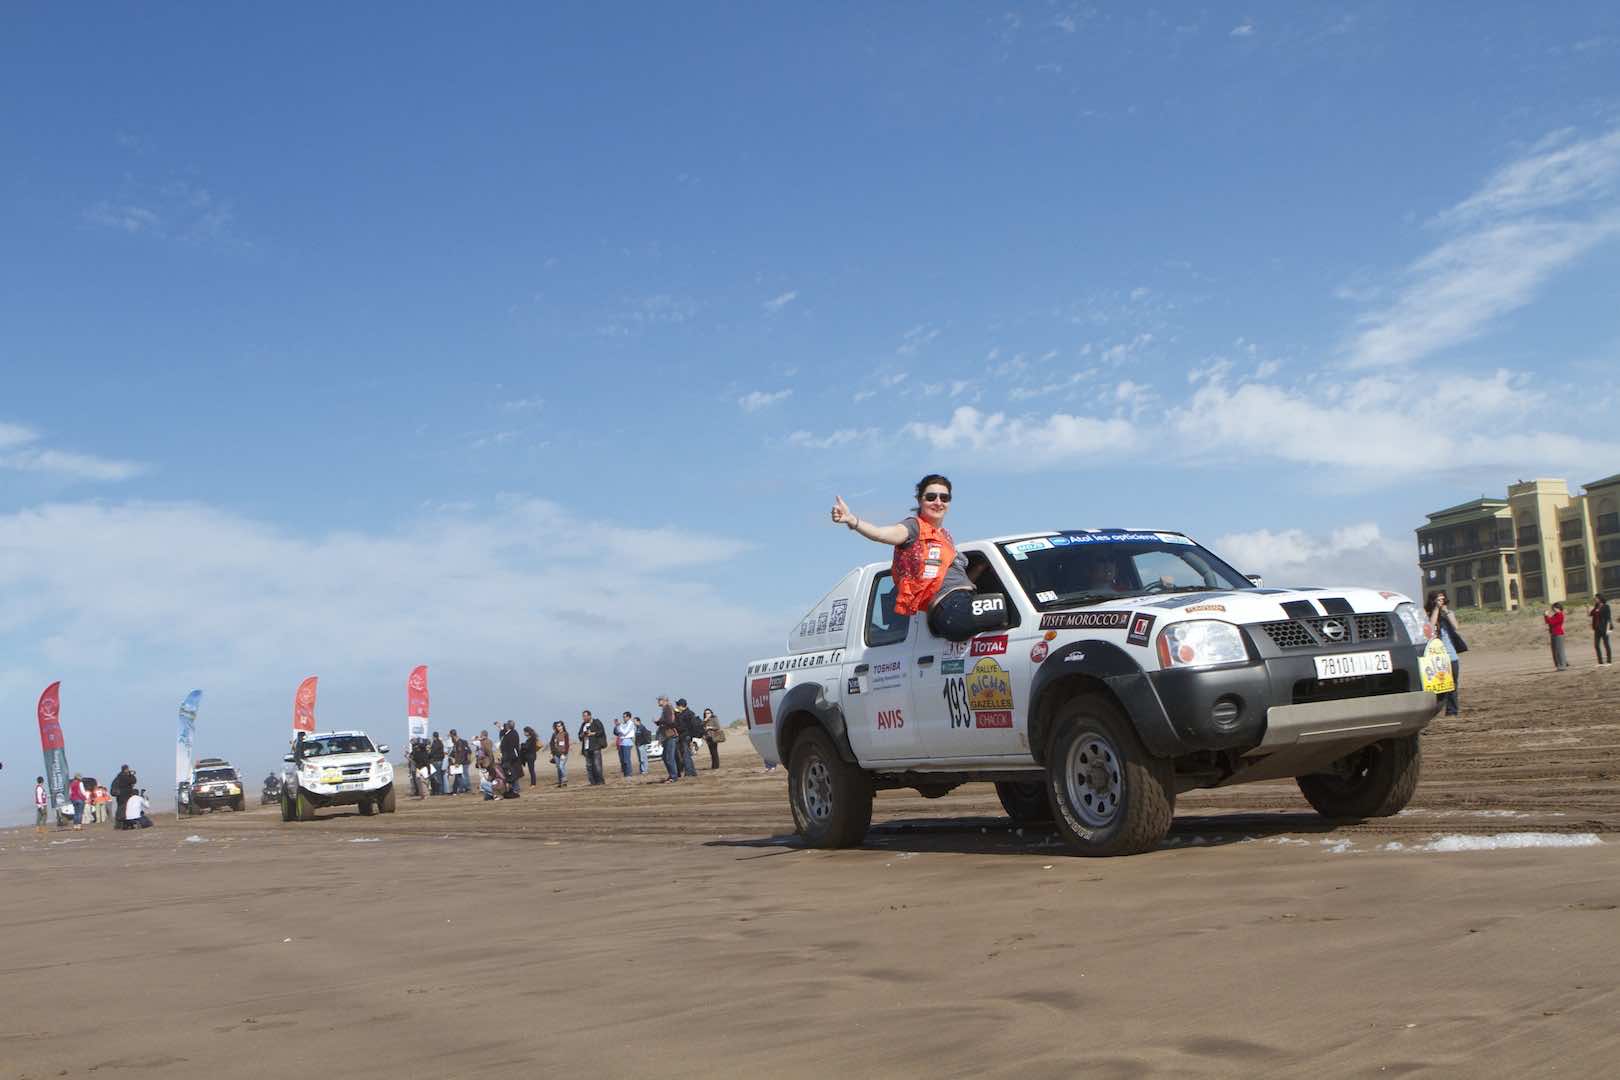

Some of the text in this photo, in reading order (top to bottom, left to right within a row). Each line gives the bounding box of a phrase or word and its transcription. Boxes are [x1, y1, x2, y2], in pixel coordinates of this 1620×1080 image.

[972, 598, 1004, 615] gan
[1042, 615, 1067, 627] VISIT
[1067, 613, 1119, 626] MOROCCO
[747, 650, 840, 675] www.novateam.fr
[873, 661, 901, 674] TOSHIBA
[975, 664, 998, 673] RALLYE
[1321, 656, 1355, 676] 78101
[1375, 654, 1389, 671] 26
[943, 677, 971, 729] 193
[970, 698, 1011, 708] GAZELLES
[878, 709, 904, 730] AVIS
